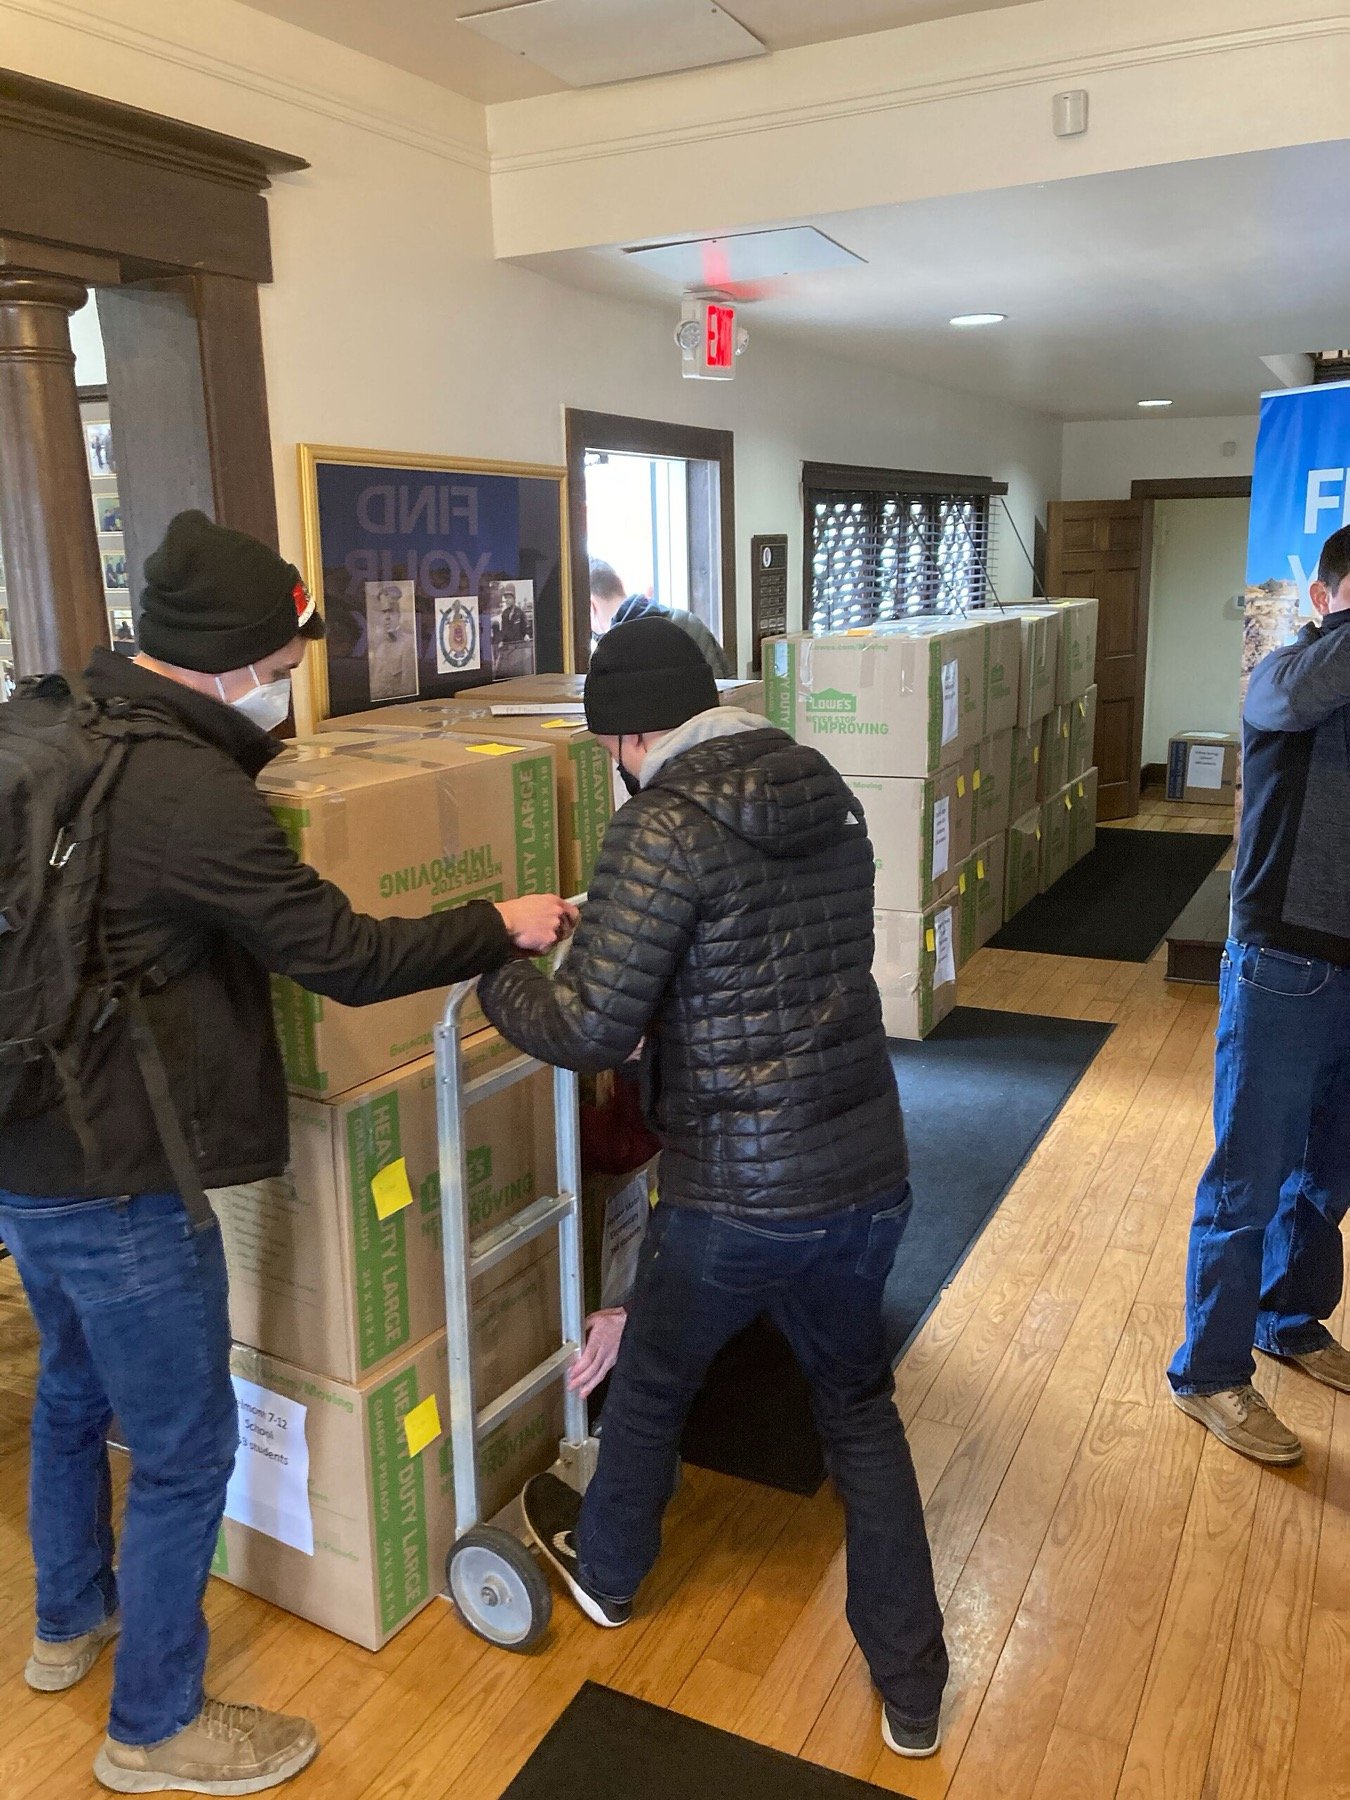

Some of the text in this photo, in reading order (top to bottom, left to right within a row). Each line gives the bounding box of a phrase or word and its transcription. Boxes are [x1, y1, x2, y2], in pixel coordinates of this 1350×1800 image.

[706, 305, 734, 367] EXIT
[811, 698, 852, 710] LOWE'S
[813, 717, 889, 735] IMPROVING
[591, 746, 605, 815] HEAVY
[519, 768, 537, 894] UTY LARGE
[379, 844, 492, 898] IMPROVING
[381, 1263, 401, 1346] LARGE
[244, 1419, 274, 1441] School
[268, 1412, 288, 1430] 7-12
[249, 1441, 289, 1466] students
[398, 1464, 417, 1525] DUTY
[402, 1529, 421, 1606] LARGE
